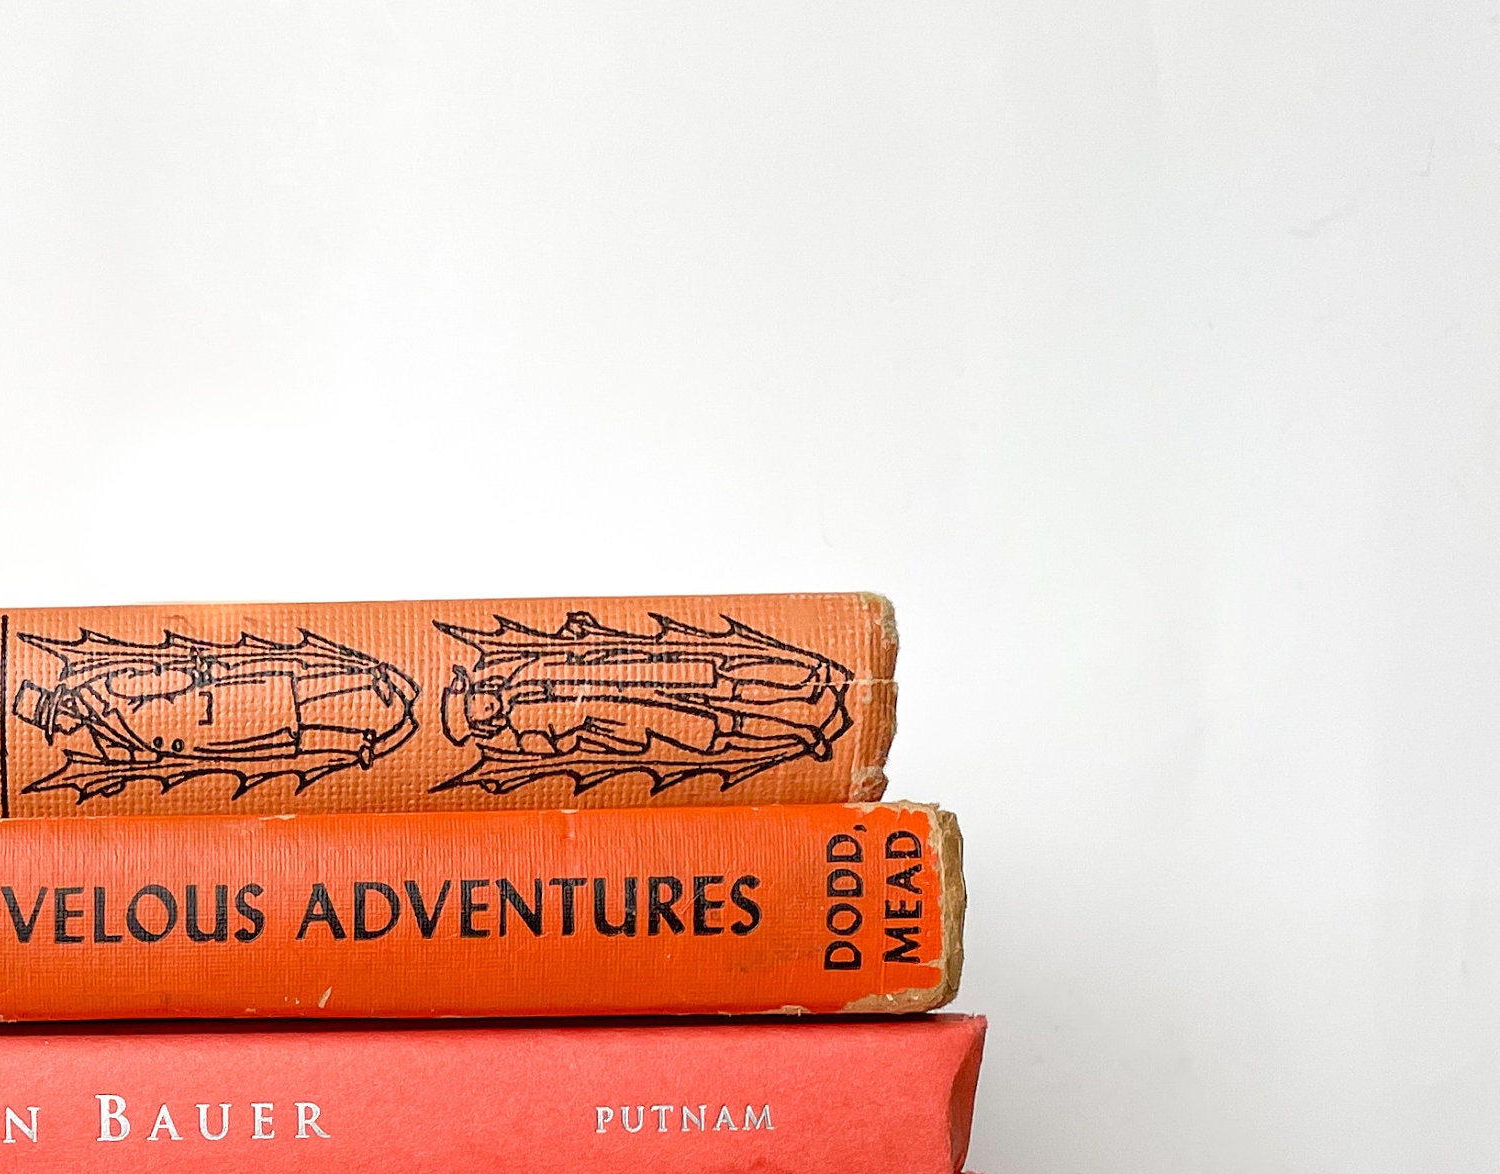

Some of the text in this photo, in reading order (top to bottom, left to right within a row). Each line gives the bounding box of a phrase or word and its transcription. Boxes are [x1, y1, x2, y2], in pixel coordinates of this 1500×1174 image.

[296, 875, 762, 940] ADVENTURES
[883, 831, 922, 963] MEAD
[95, 1095, 330, 1141] BAUER
[596, 1105, 774, 1133] PUTNAM
